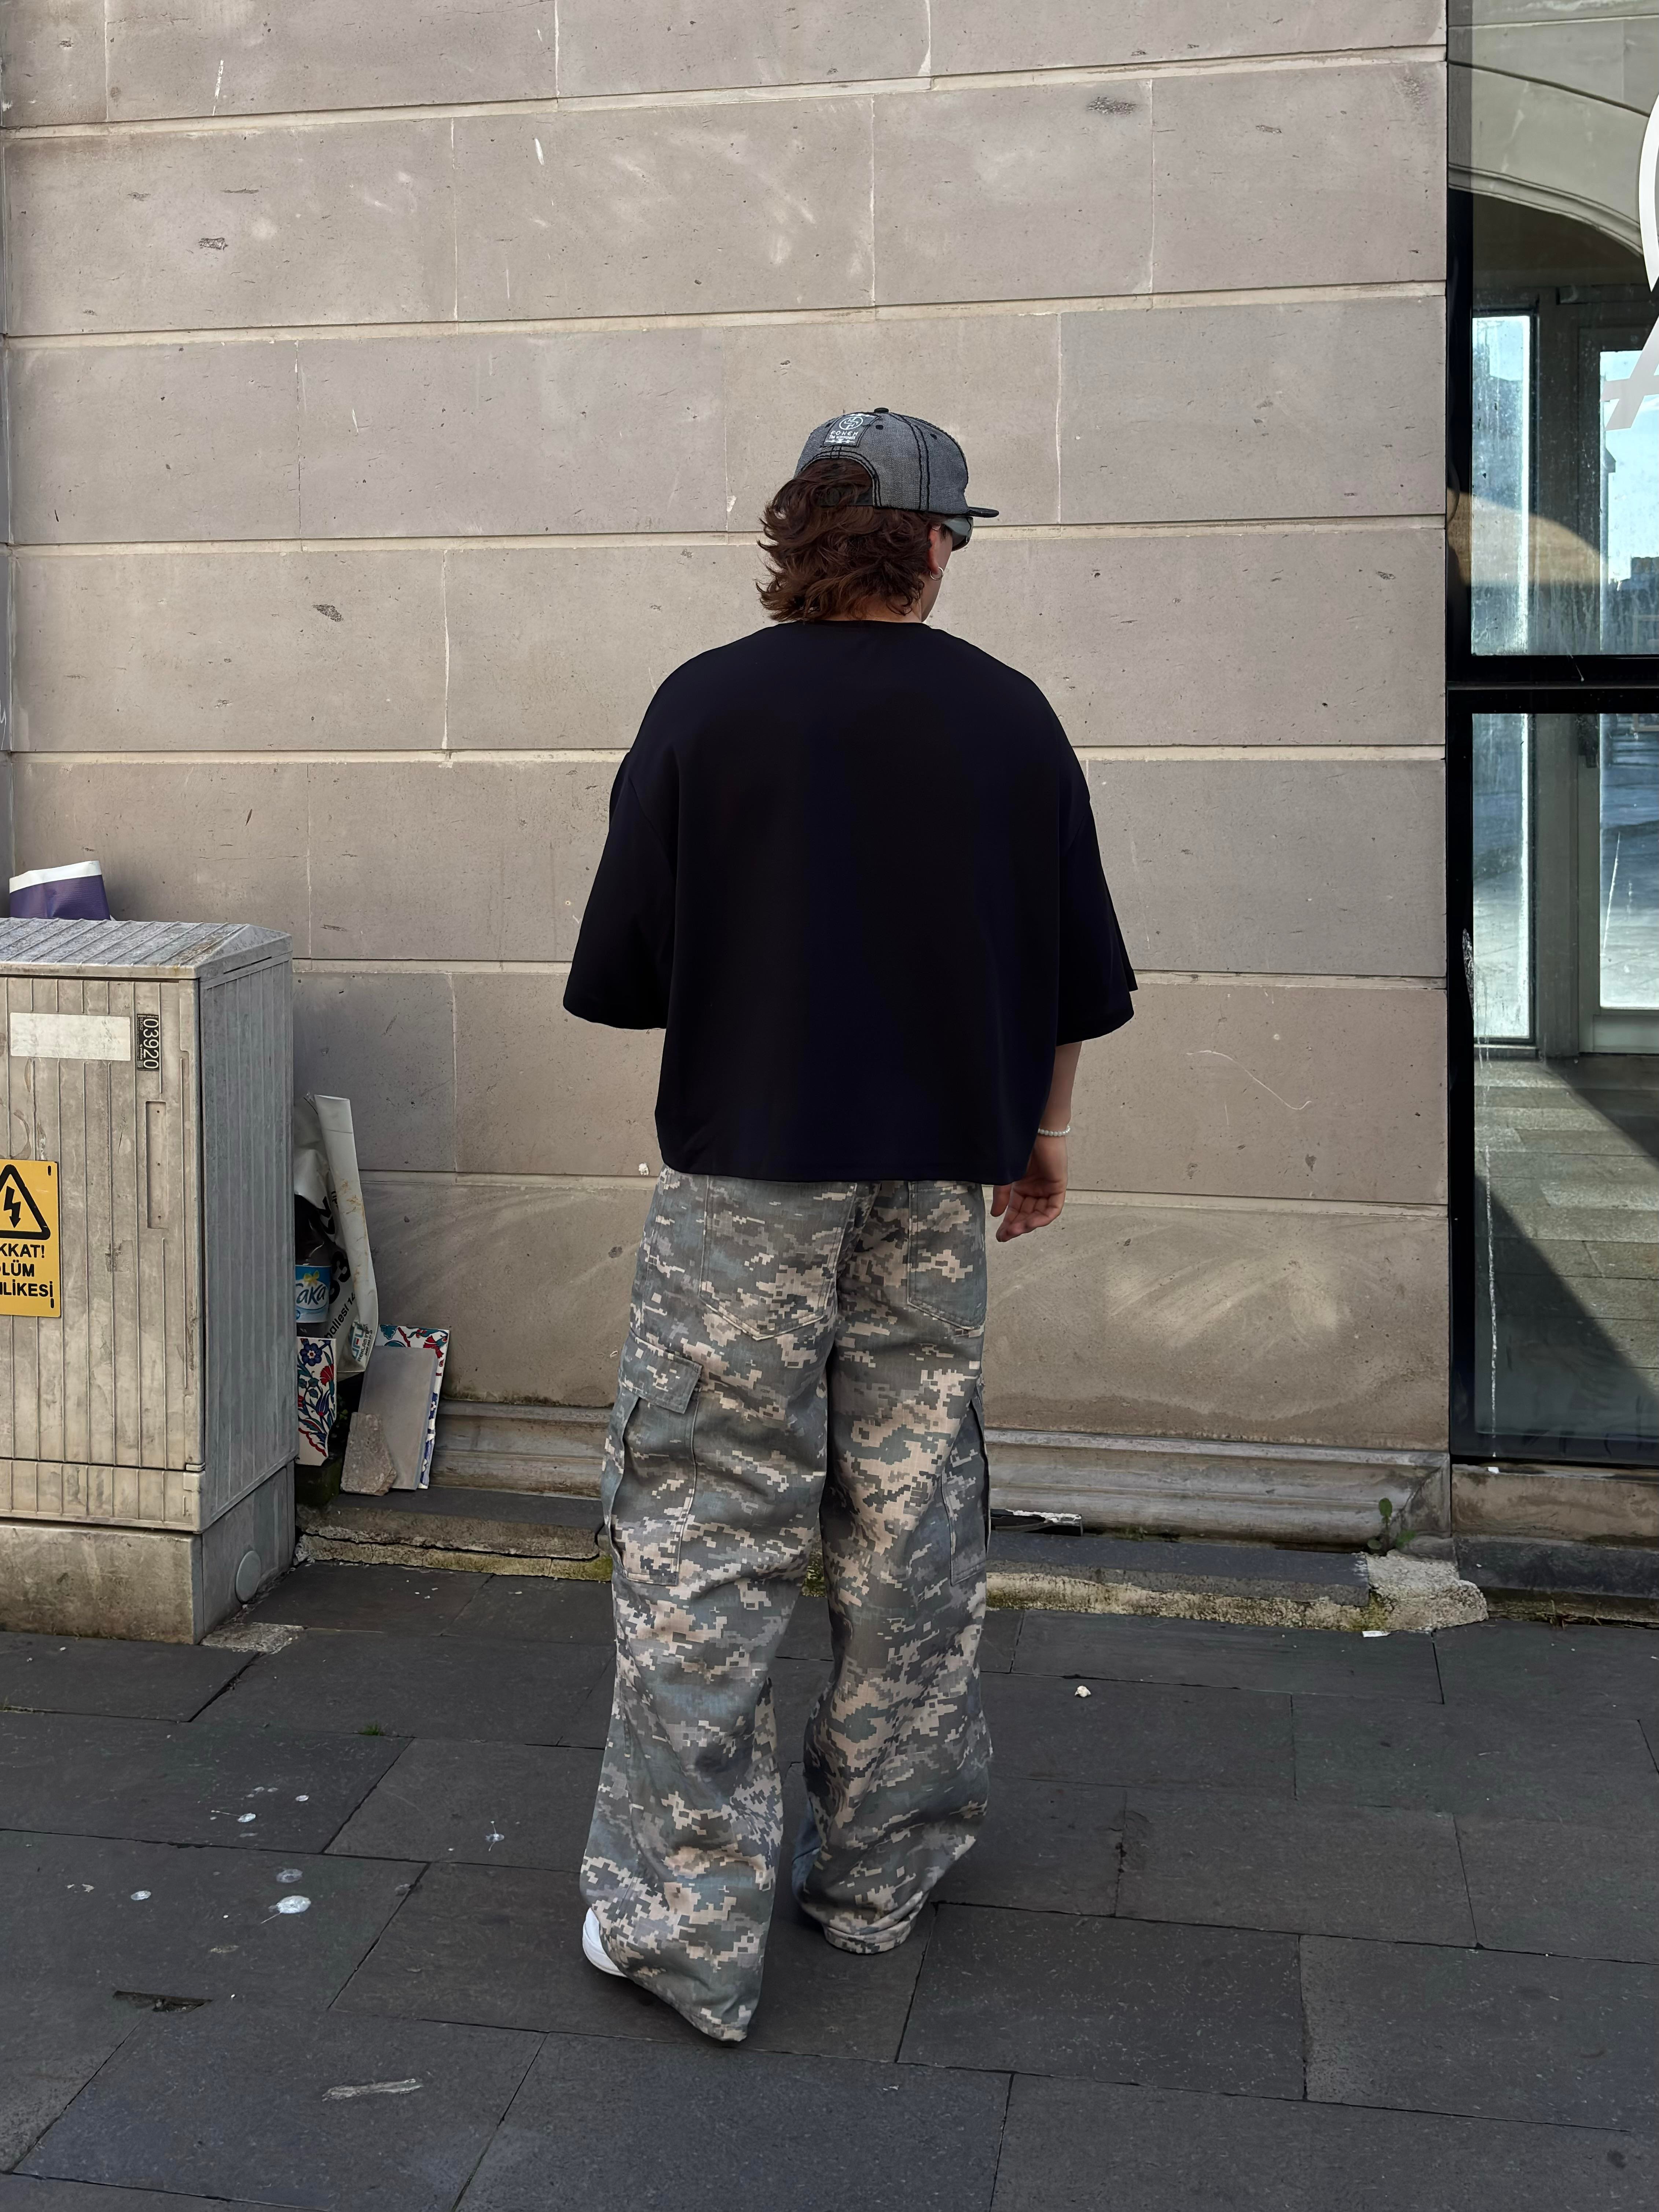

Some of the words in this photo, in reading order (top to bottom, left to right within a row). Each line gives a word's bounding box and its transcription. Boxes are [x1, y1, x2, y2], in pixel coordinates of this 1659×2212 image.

[143, 1019, 159, 1069] 03920
[0, 1259, 34, 1277] LÜM
[0, 1279, 53, 1298] LİKESİ
